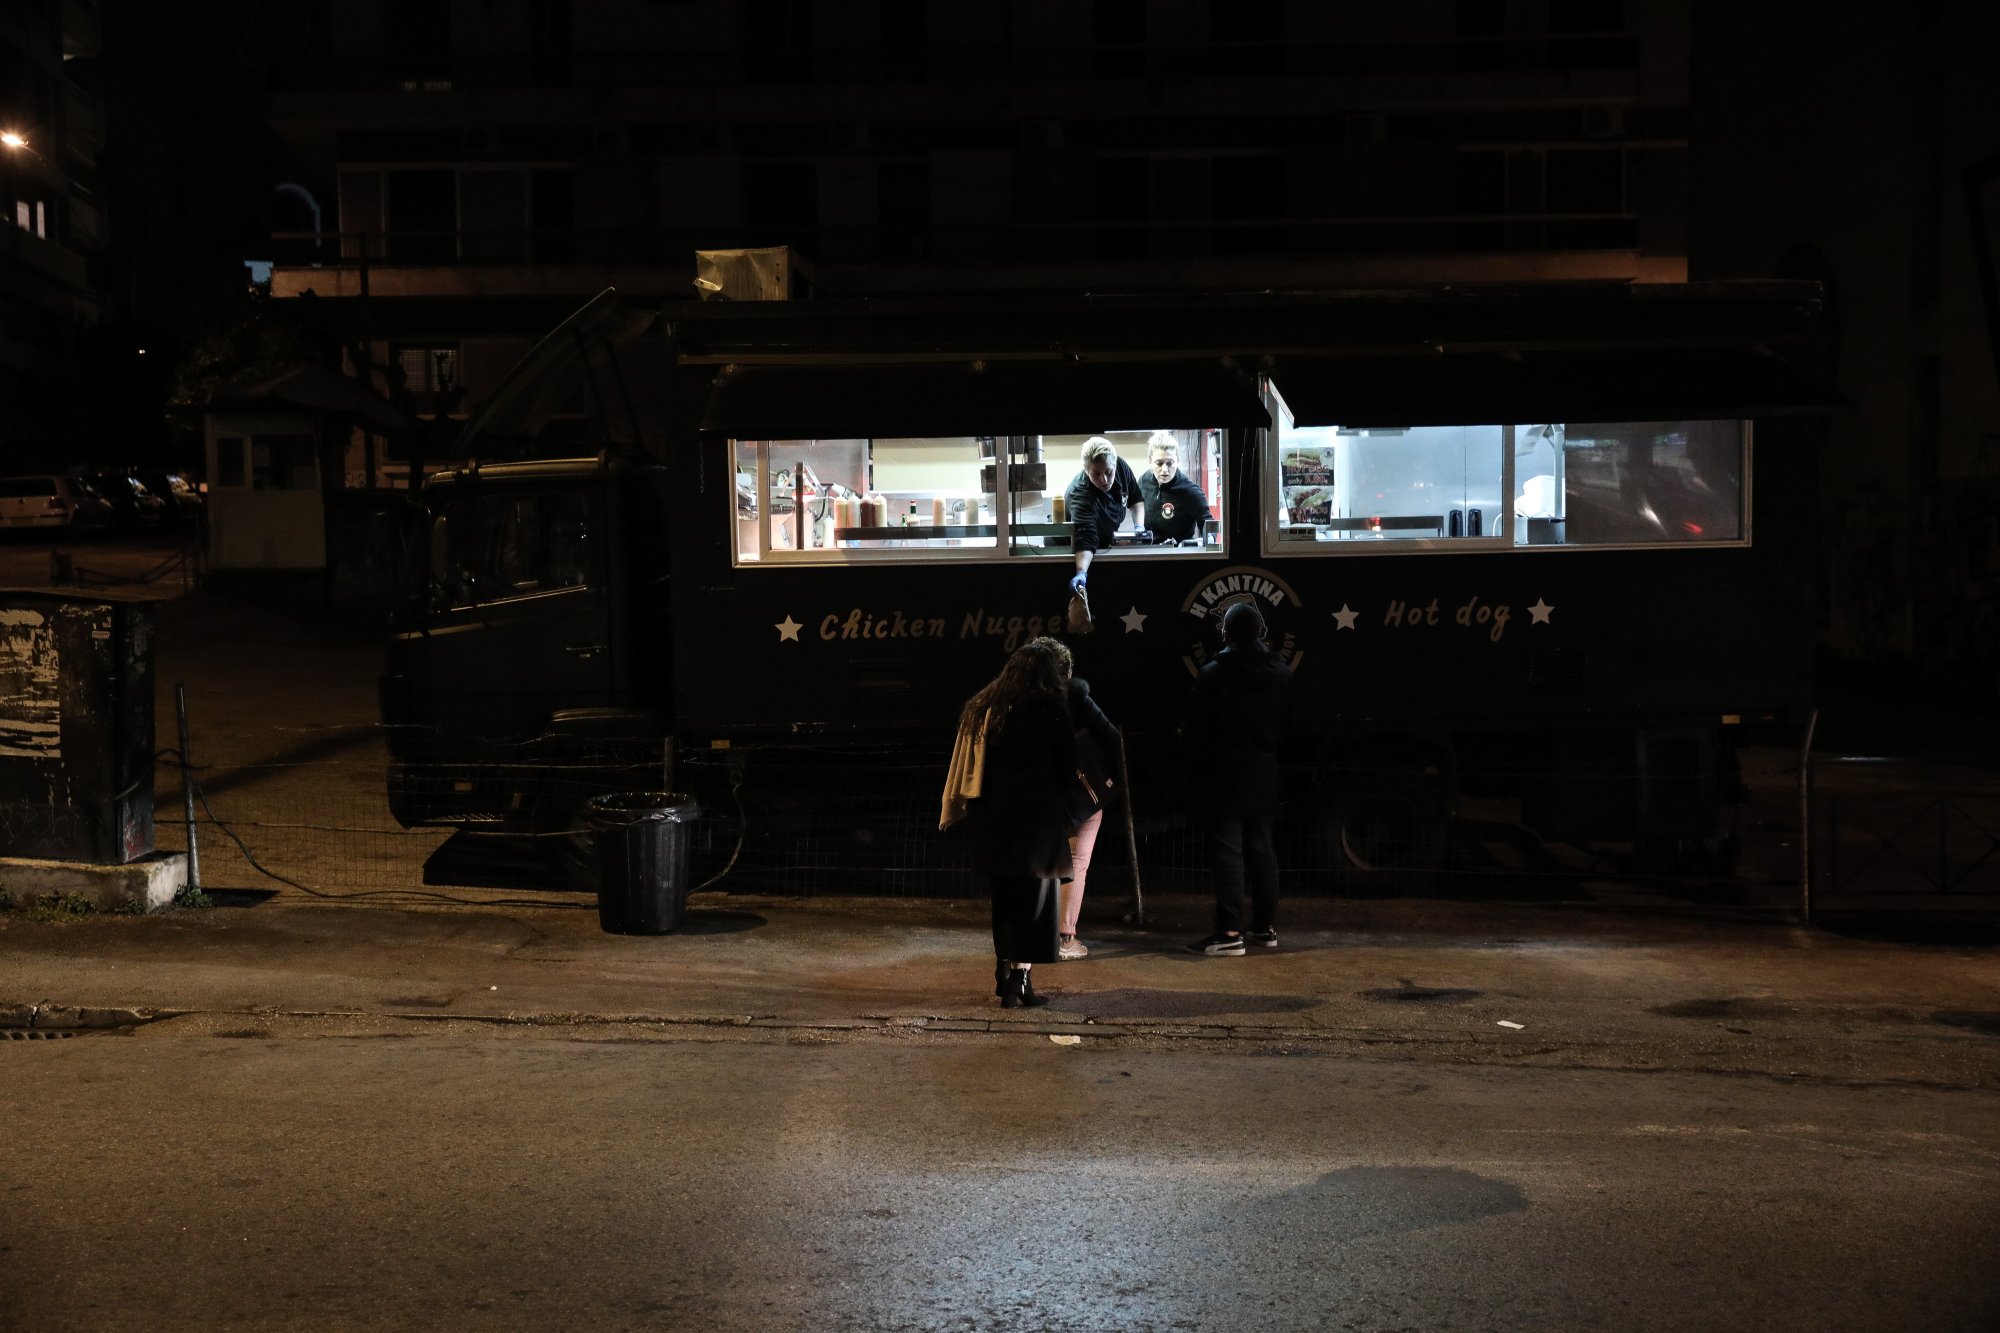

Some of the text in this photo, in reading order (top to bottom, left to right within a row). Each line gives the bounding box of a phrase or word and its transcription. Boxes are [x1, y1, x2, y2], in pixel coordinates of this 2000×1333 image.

[819, 607, 1096, 653] Chicken Nugge
[1384, 596, 1511, 642] Hot dog
